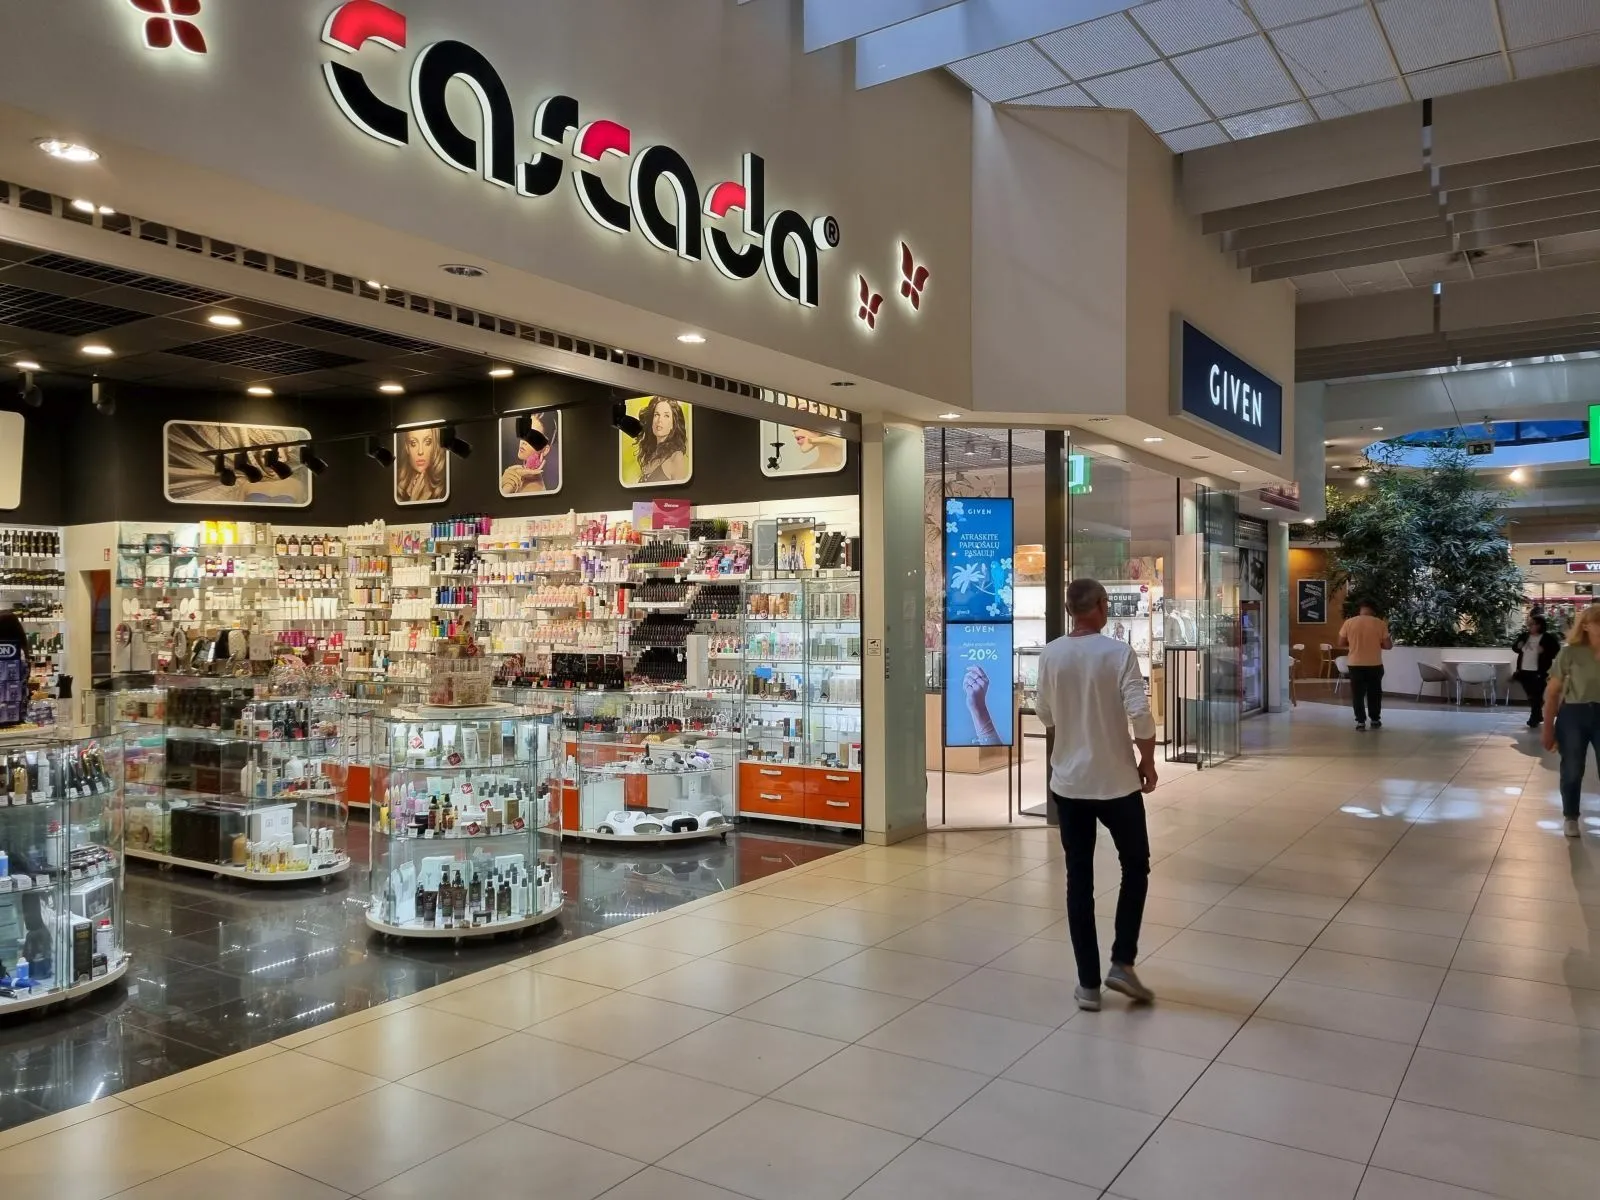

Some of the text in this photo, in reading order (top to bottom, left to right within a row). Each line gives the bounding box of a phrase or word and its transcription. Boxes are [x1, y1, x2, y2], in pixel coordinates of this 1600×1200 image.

[1209, 363, 1262, 428] GIVEN
[960, 533, 999, 541] ATRASKITE
[964, 625, 995, 633] GIVEN
[960, 648, 998, 661] -20%
